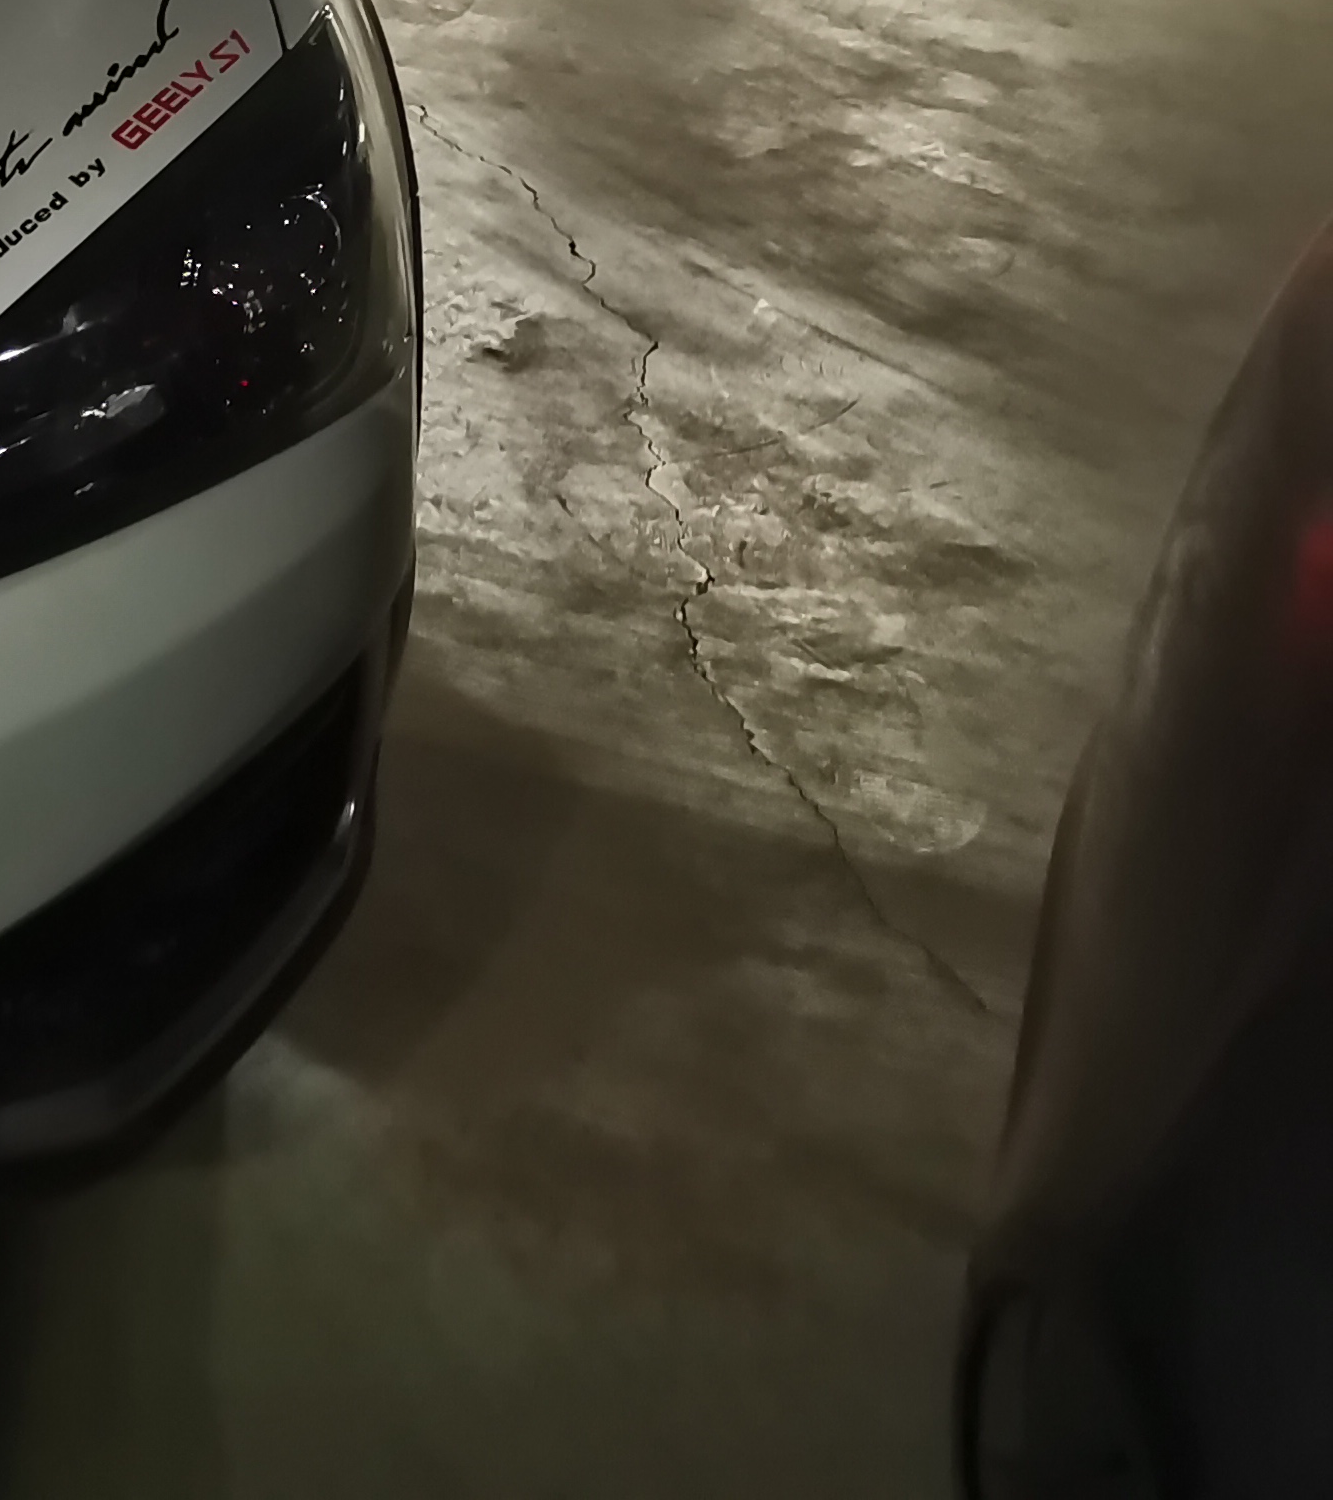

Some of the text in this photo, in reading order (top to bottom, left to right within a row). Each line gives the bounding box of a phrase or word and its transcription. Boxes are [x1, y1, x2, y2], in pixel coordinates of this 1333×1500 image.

[68, 157, 107, 188] by
[111, 59, 214, 151] GEELY
[208, 29, 251, 74] S1
